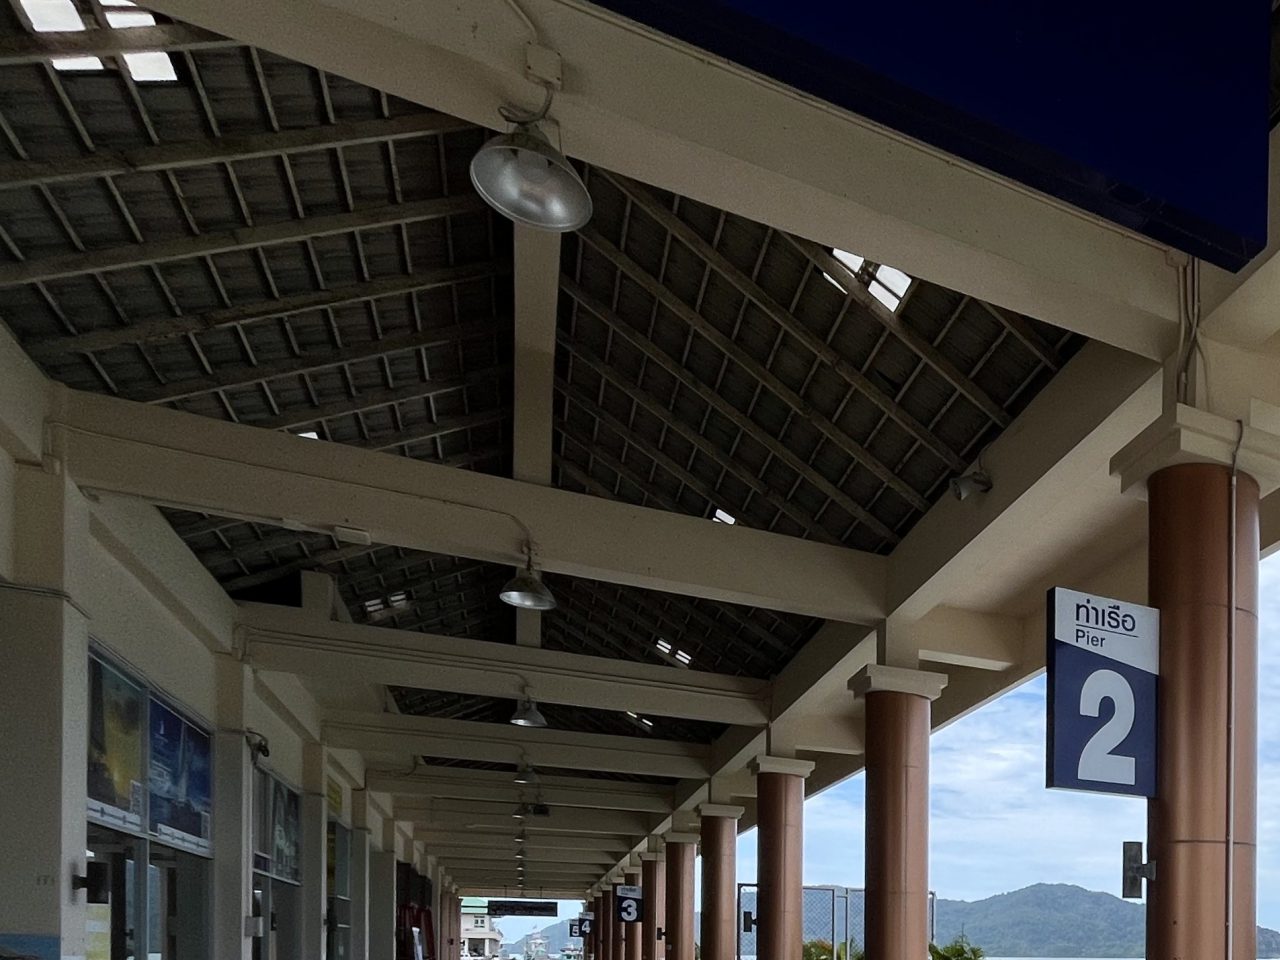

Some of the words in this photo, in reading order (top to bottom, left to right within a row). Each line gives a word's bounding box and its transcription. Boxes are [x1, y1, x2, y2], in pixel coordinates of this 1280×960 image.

[1076, 599, 1136, 632] ท่าเรือ
[1076, 629, 1106, 648] Pier
[1078, 669, 1136, 786] 2
[621, 899, 638, 921] 3
[571, 925, 580, 937] 5
[581, 920, 591, 934] 4
